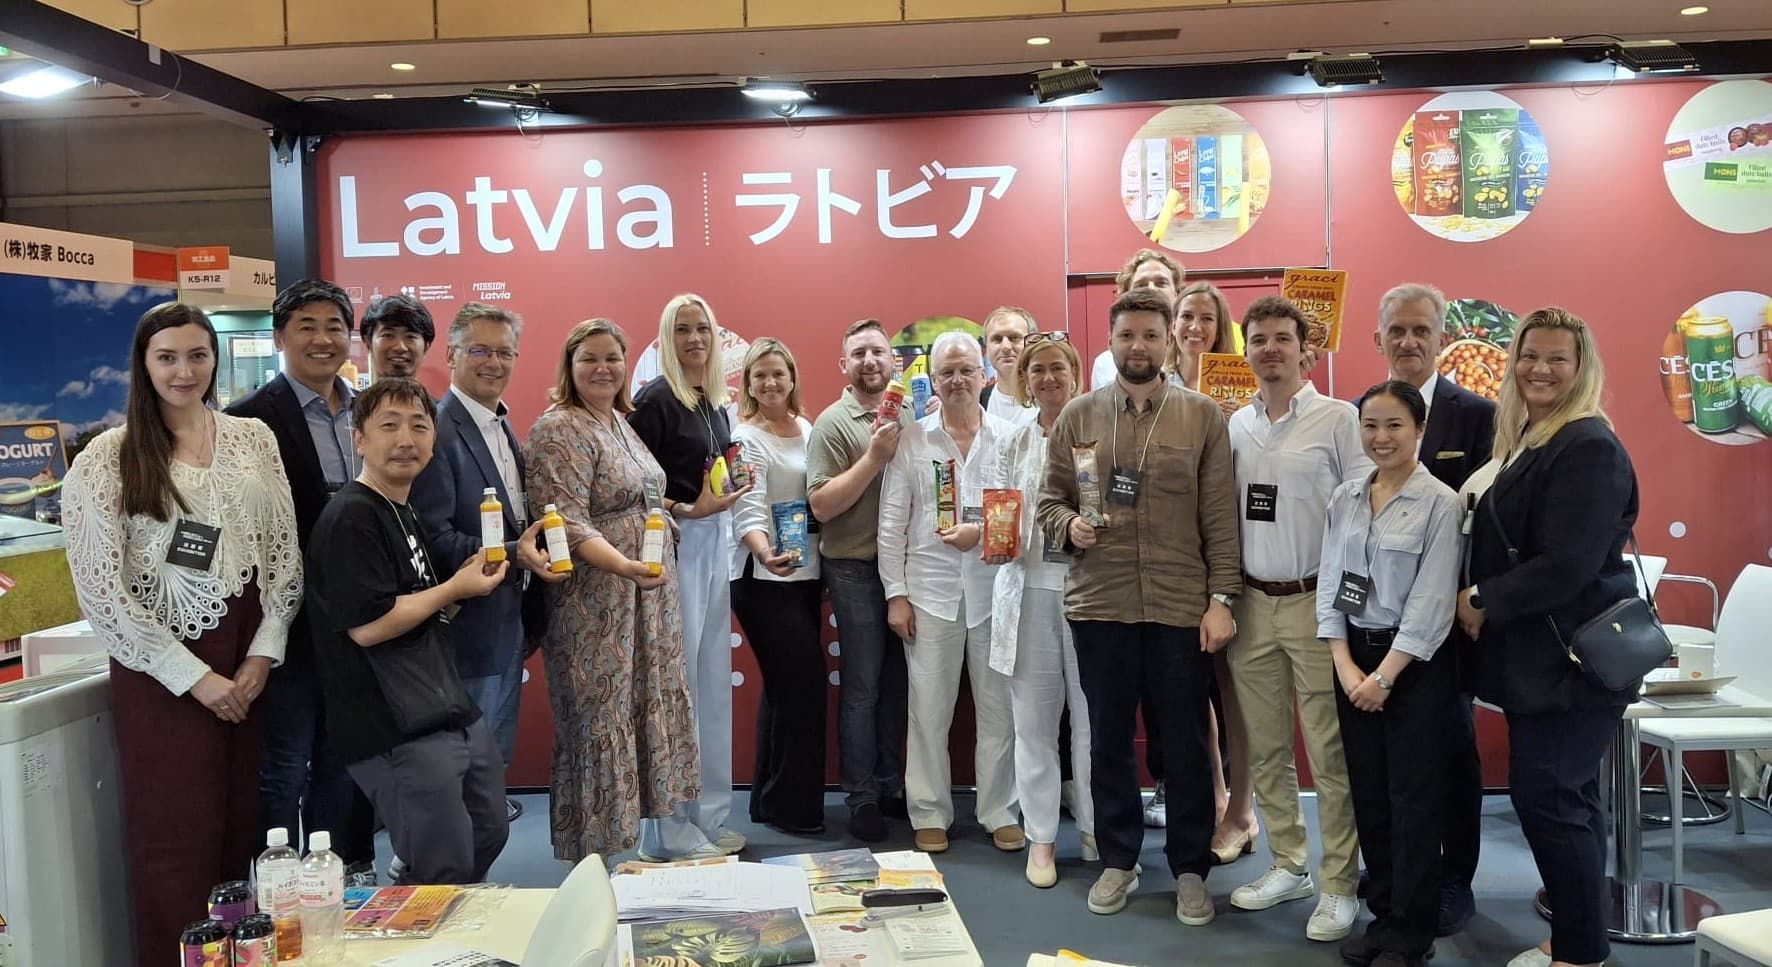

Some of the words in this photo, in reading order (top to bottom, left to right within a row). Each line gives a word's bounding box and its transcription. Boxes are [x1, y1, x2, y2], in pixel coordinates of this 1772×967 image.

[339, 159, 674, 258] Latvia
[735, 159, 1018, 246] ラトビア
[4, 239, 53, 262] (株)牧家
[57, 246, 95, 265] Bocca
[188, 275, 221, 284] K5-R12
[472, 282, 506, 291] MISSION
[480, 291, 511, 300] Latvia
[1288, 289, 1336, 302] CARAMEL
[1207, 376, 1257, 388] CARAMEL
[1209, 386, 1252, 399] RINGS
